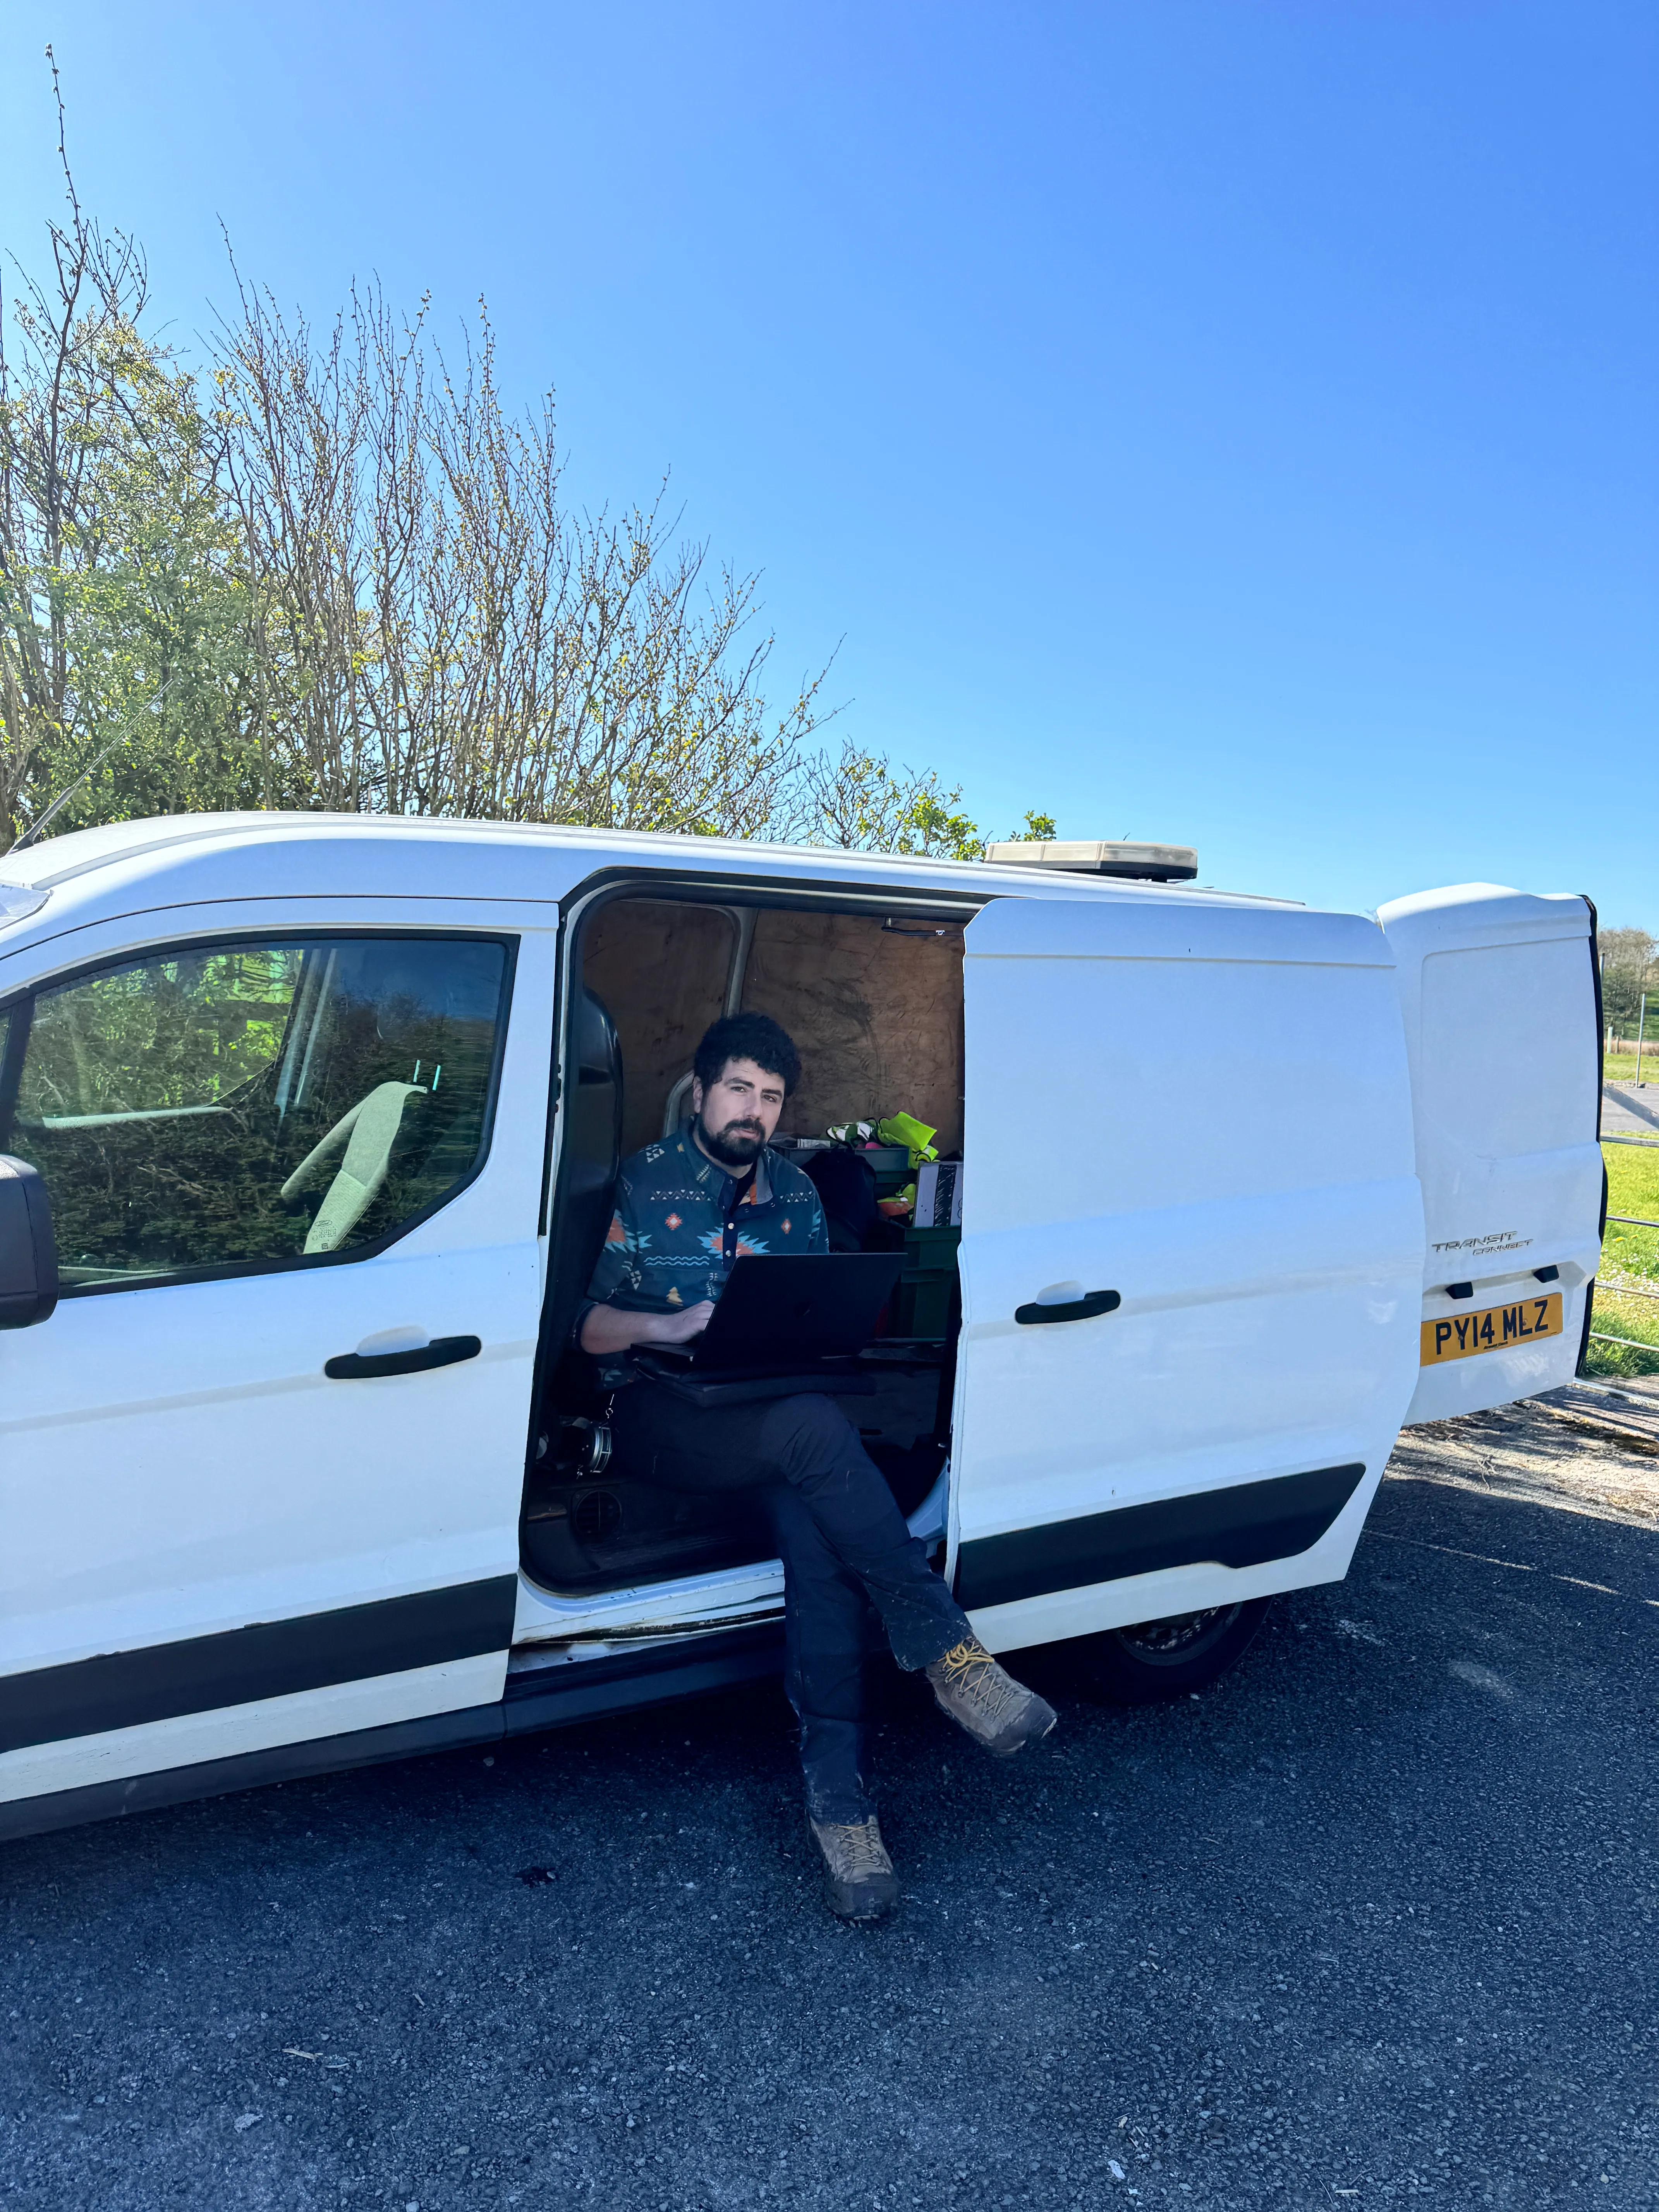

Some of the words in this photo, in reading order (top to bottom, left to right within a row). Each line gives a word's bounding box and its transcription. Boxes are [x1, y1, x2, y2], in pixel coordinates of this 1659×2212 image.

[1432, 1231, 1517, 1252] TRANSIT
[1473, 1239, 1533, 1255] CONNECT
[1436, 1313, 1495, 1355] PY14
[1503, 1299, 1548, 1340] MLZ
